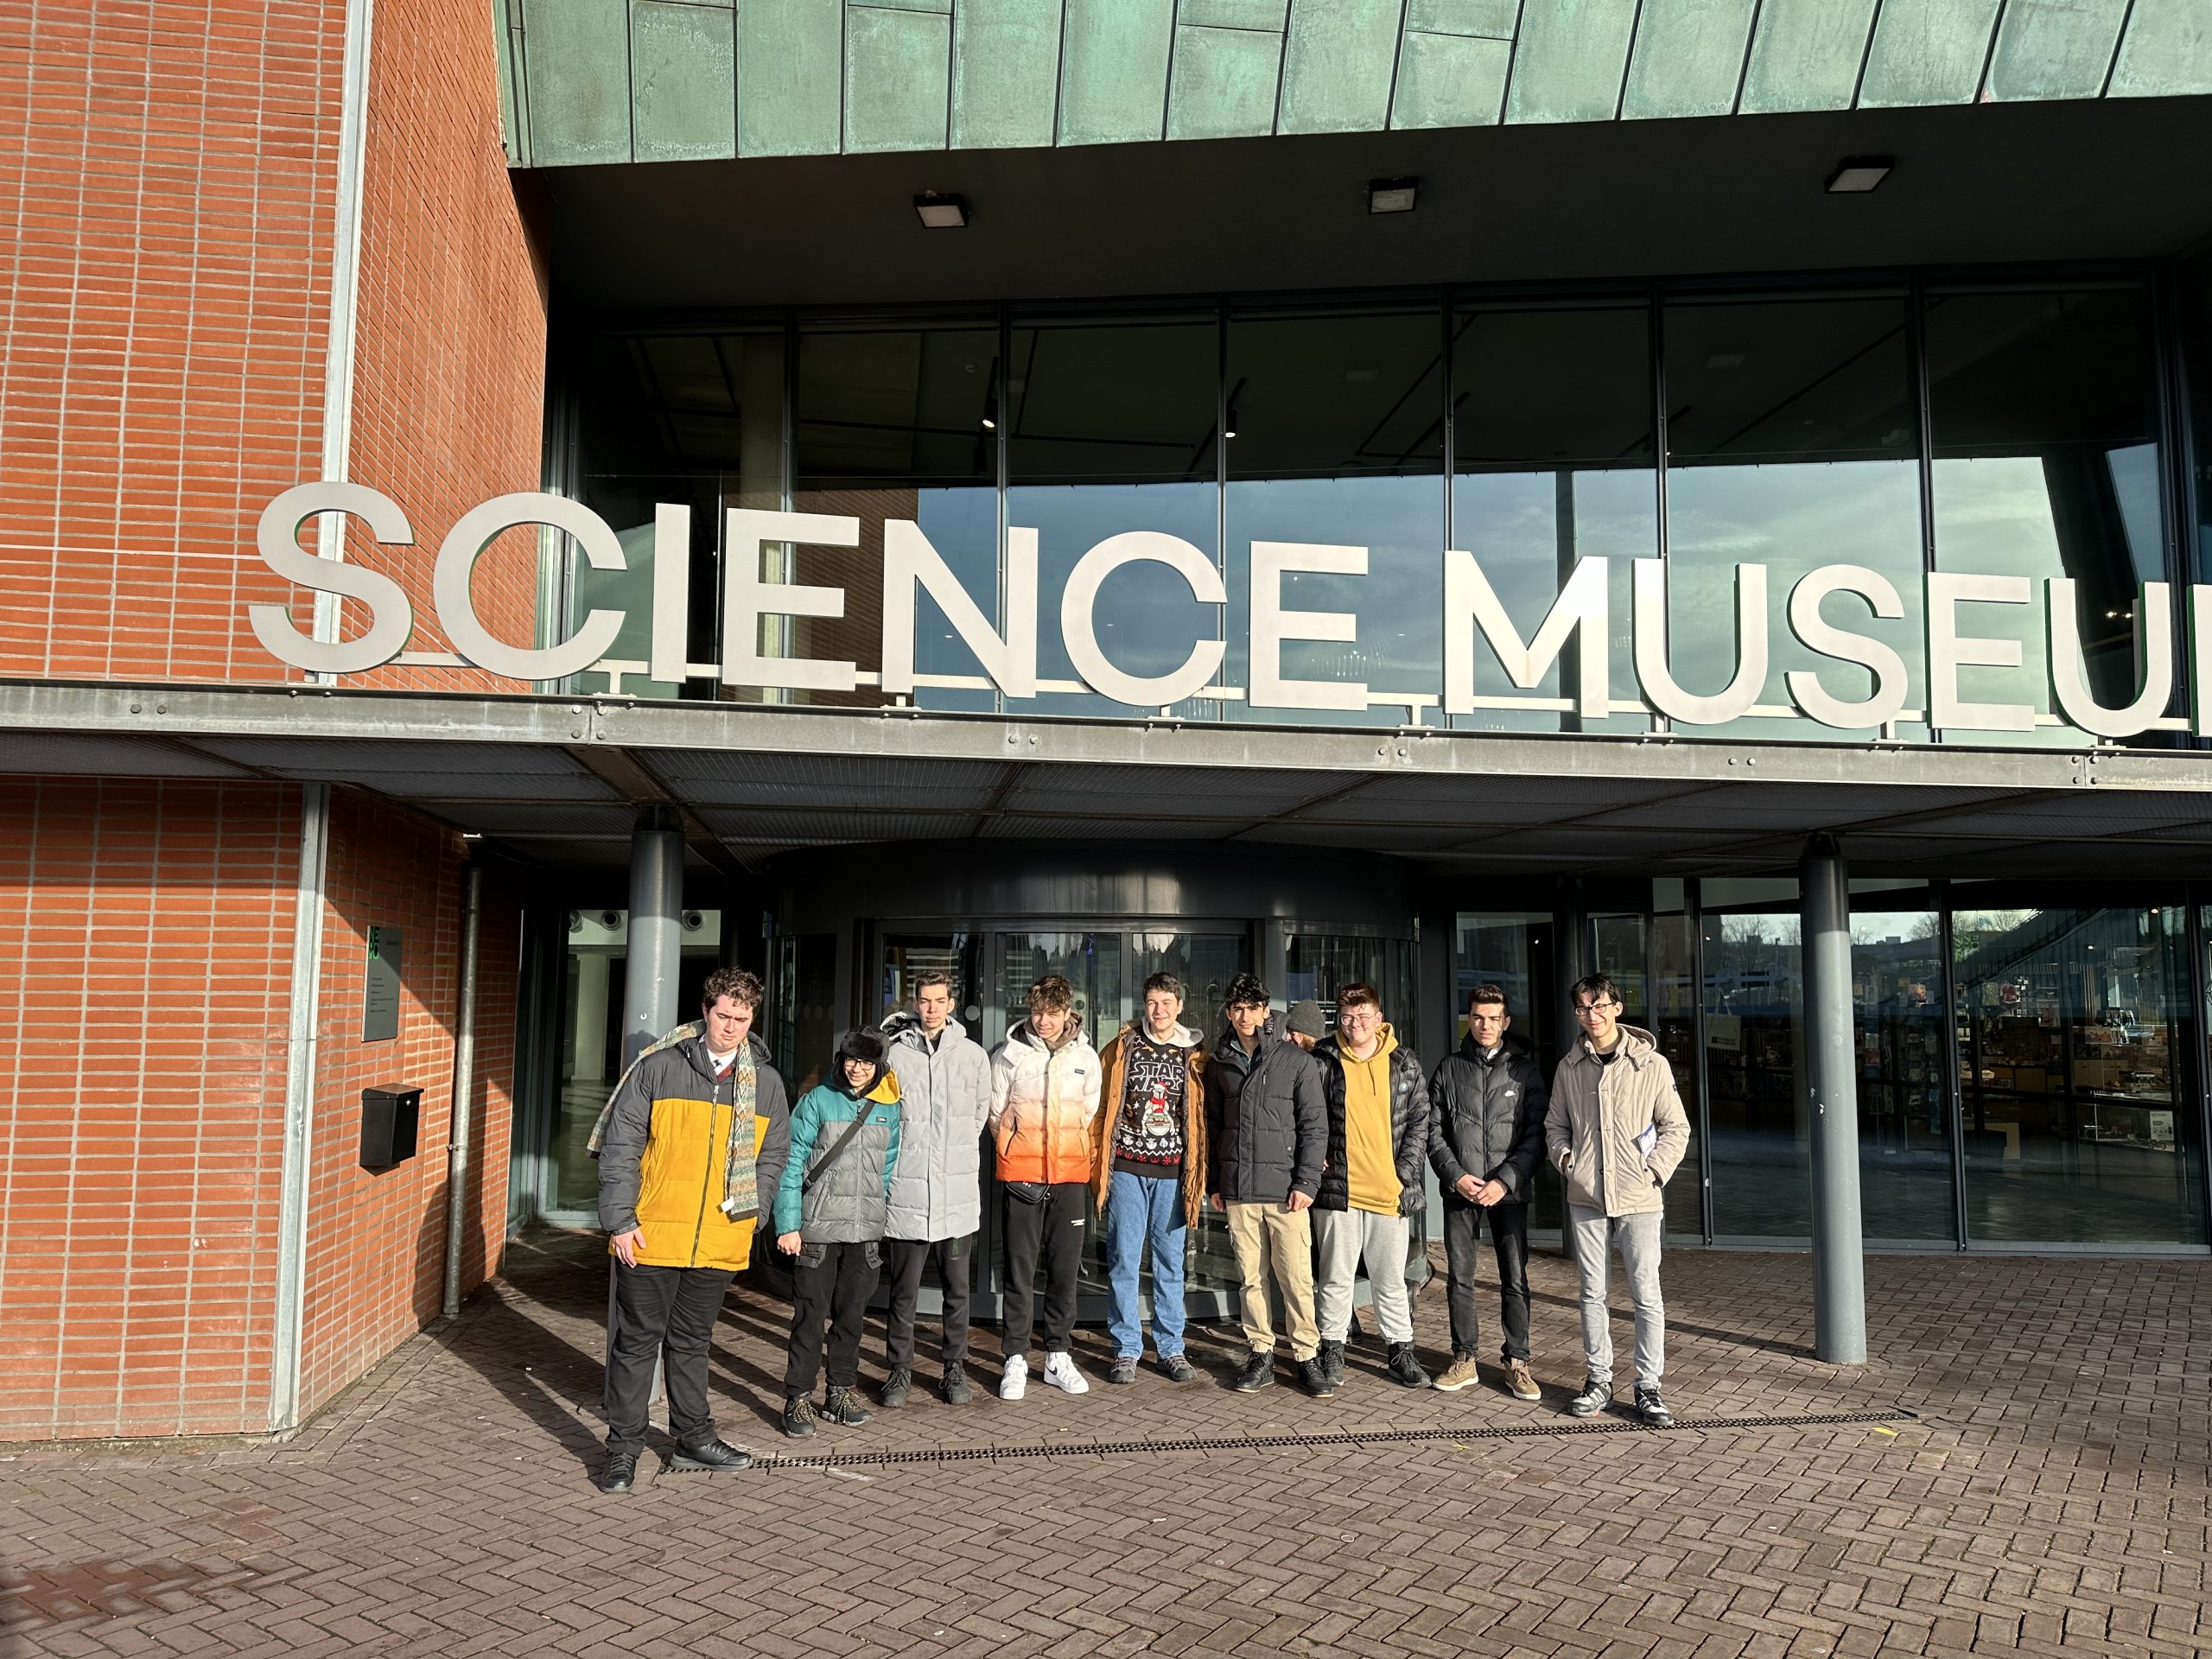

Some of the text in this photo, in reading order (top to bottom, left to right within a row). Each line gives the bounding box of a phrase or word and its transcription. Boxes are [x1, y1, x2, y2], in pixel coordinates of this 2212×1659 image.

[248, 481, 2212, 737] SCIENCE MUSEU
[1128, 1061, 1185, 1079] STAR
[1128, 1076, 1184, 1096] WARS
